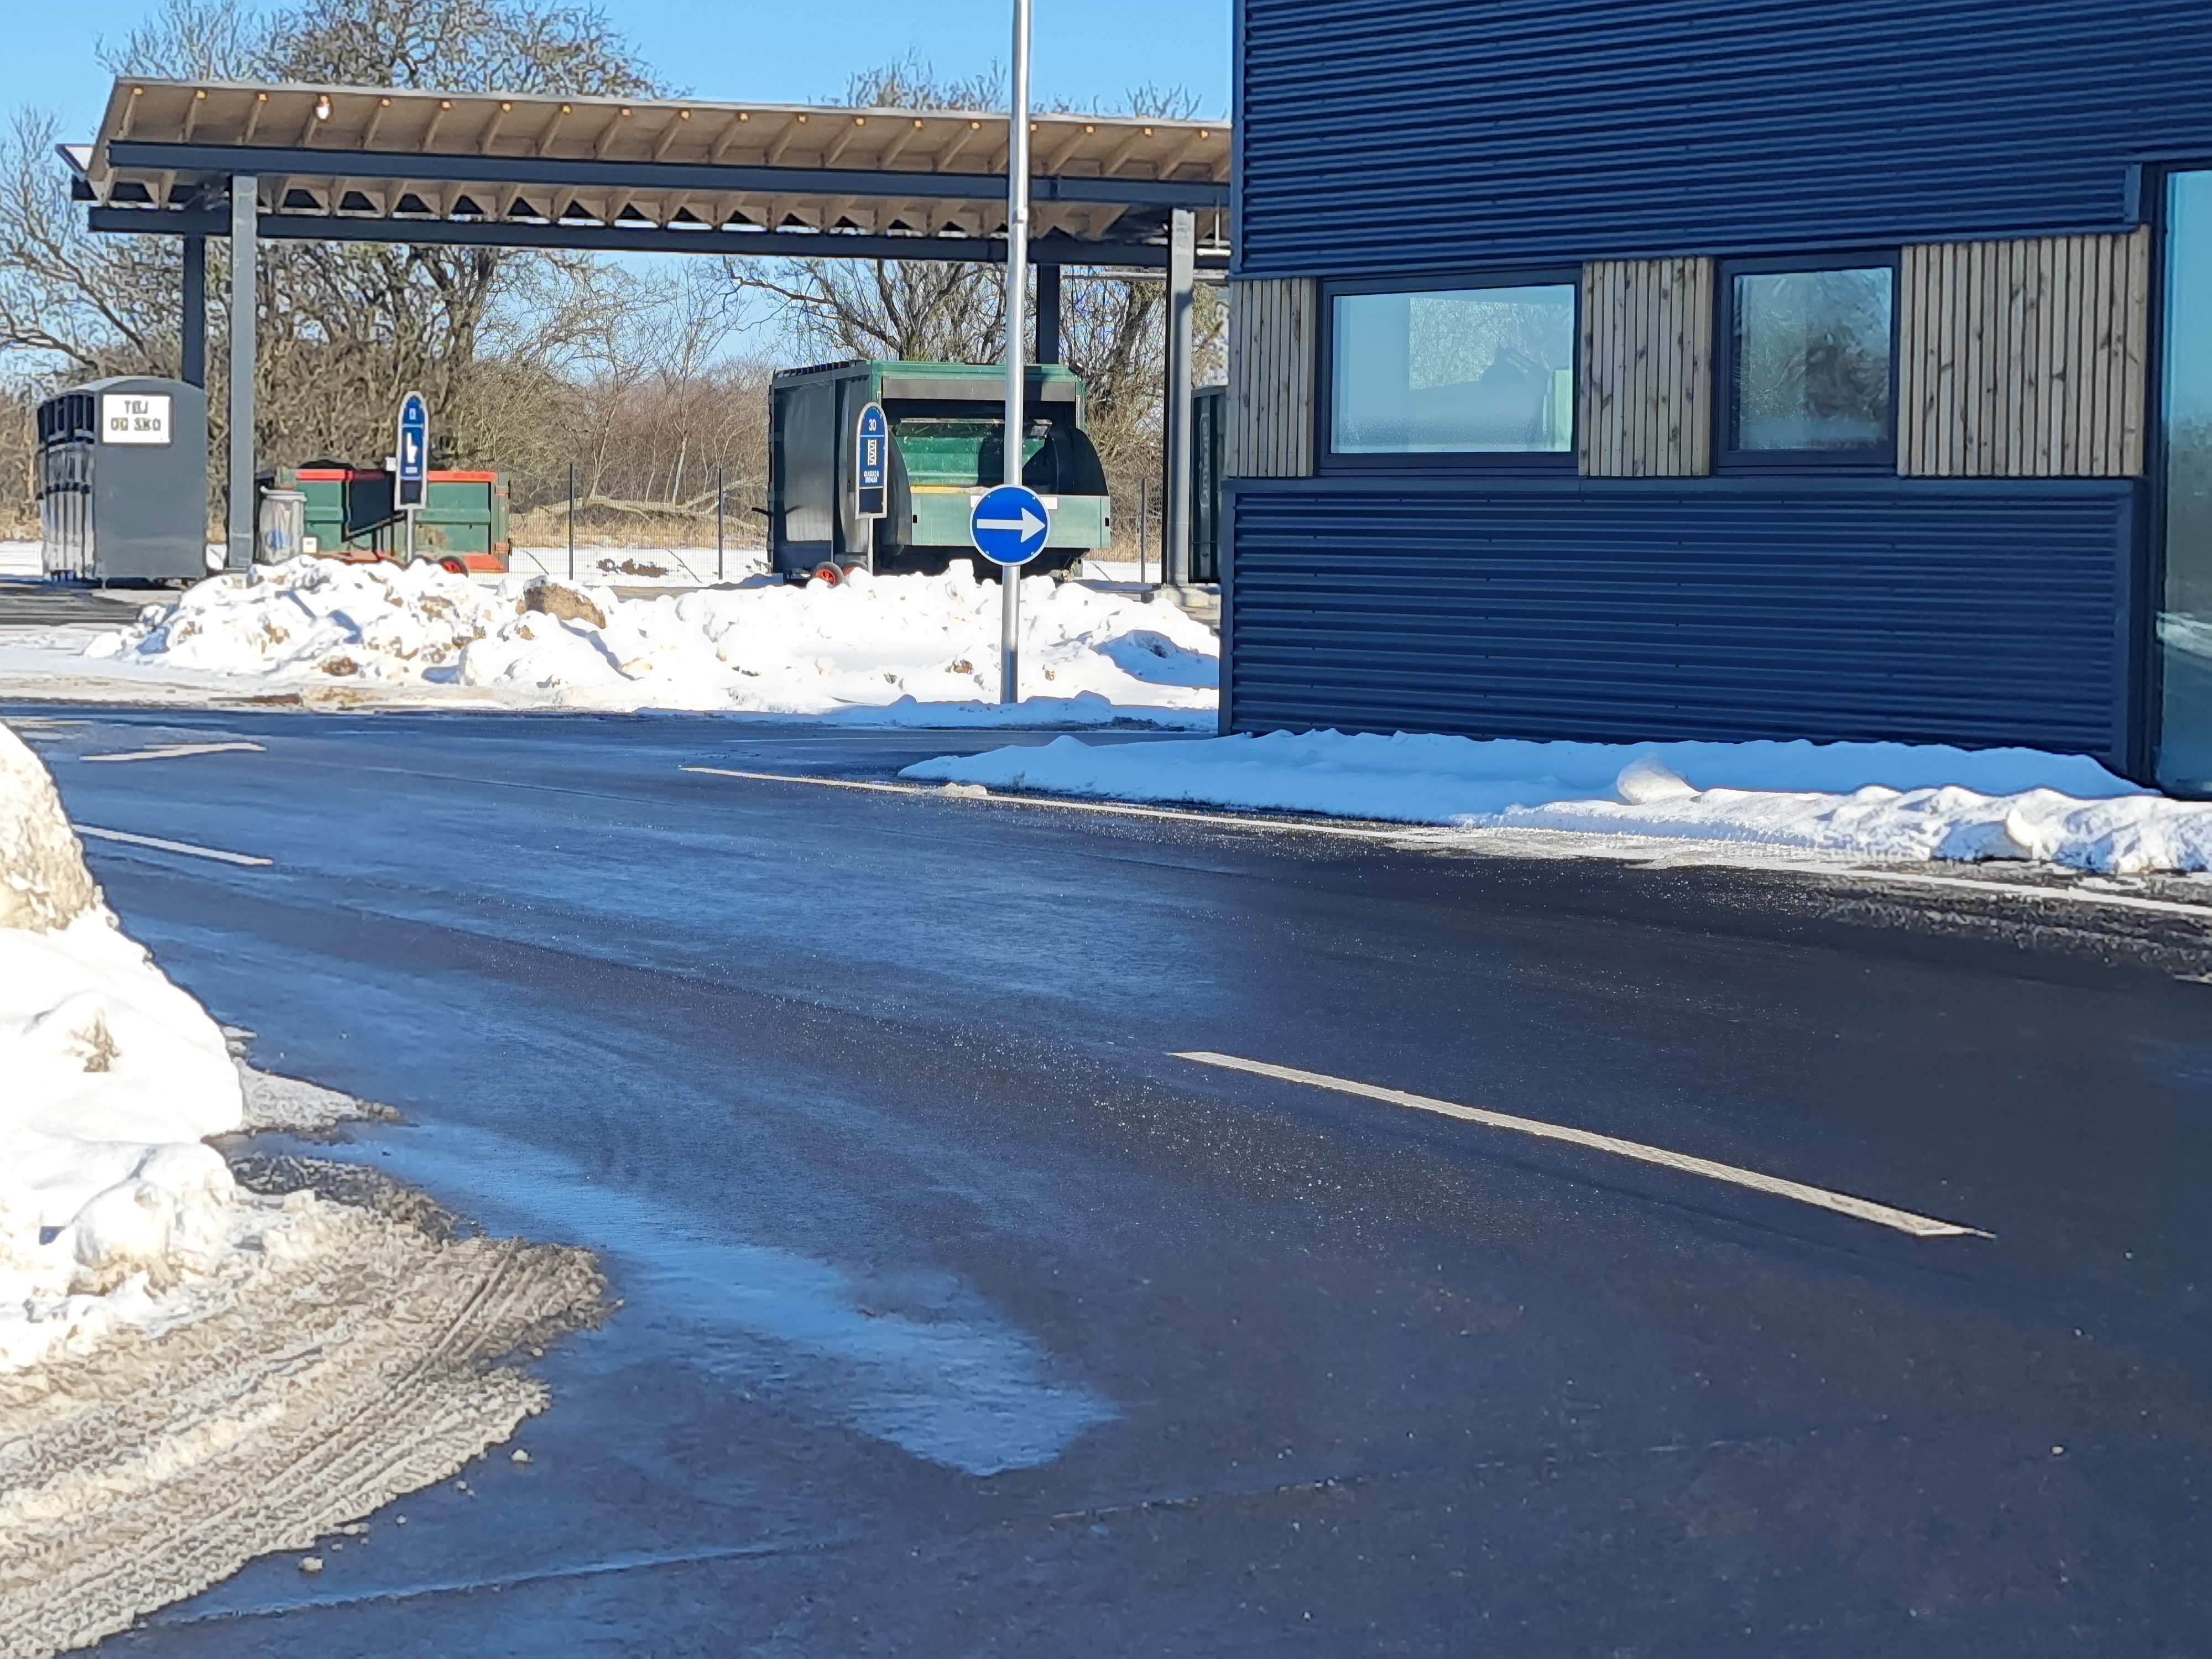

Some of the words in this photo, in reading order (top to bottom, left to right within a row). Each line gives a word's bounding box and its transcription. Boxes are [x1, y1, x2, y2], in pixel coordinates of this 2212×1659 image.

[111, 418, 128, 431] OG
[134, 417, 161, 431] SKO
[869, 419, 877, 431] 30
